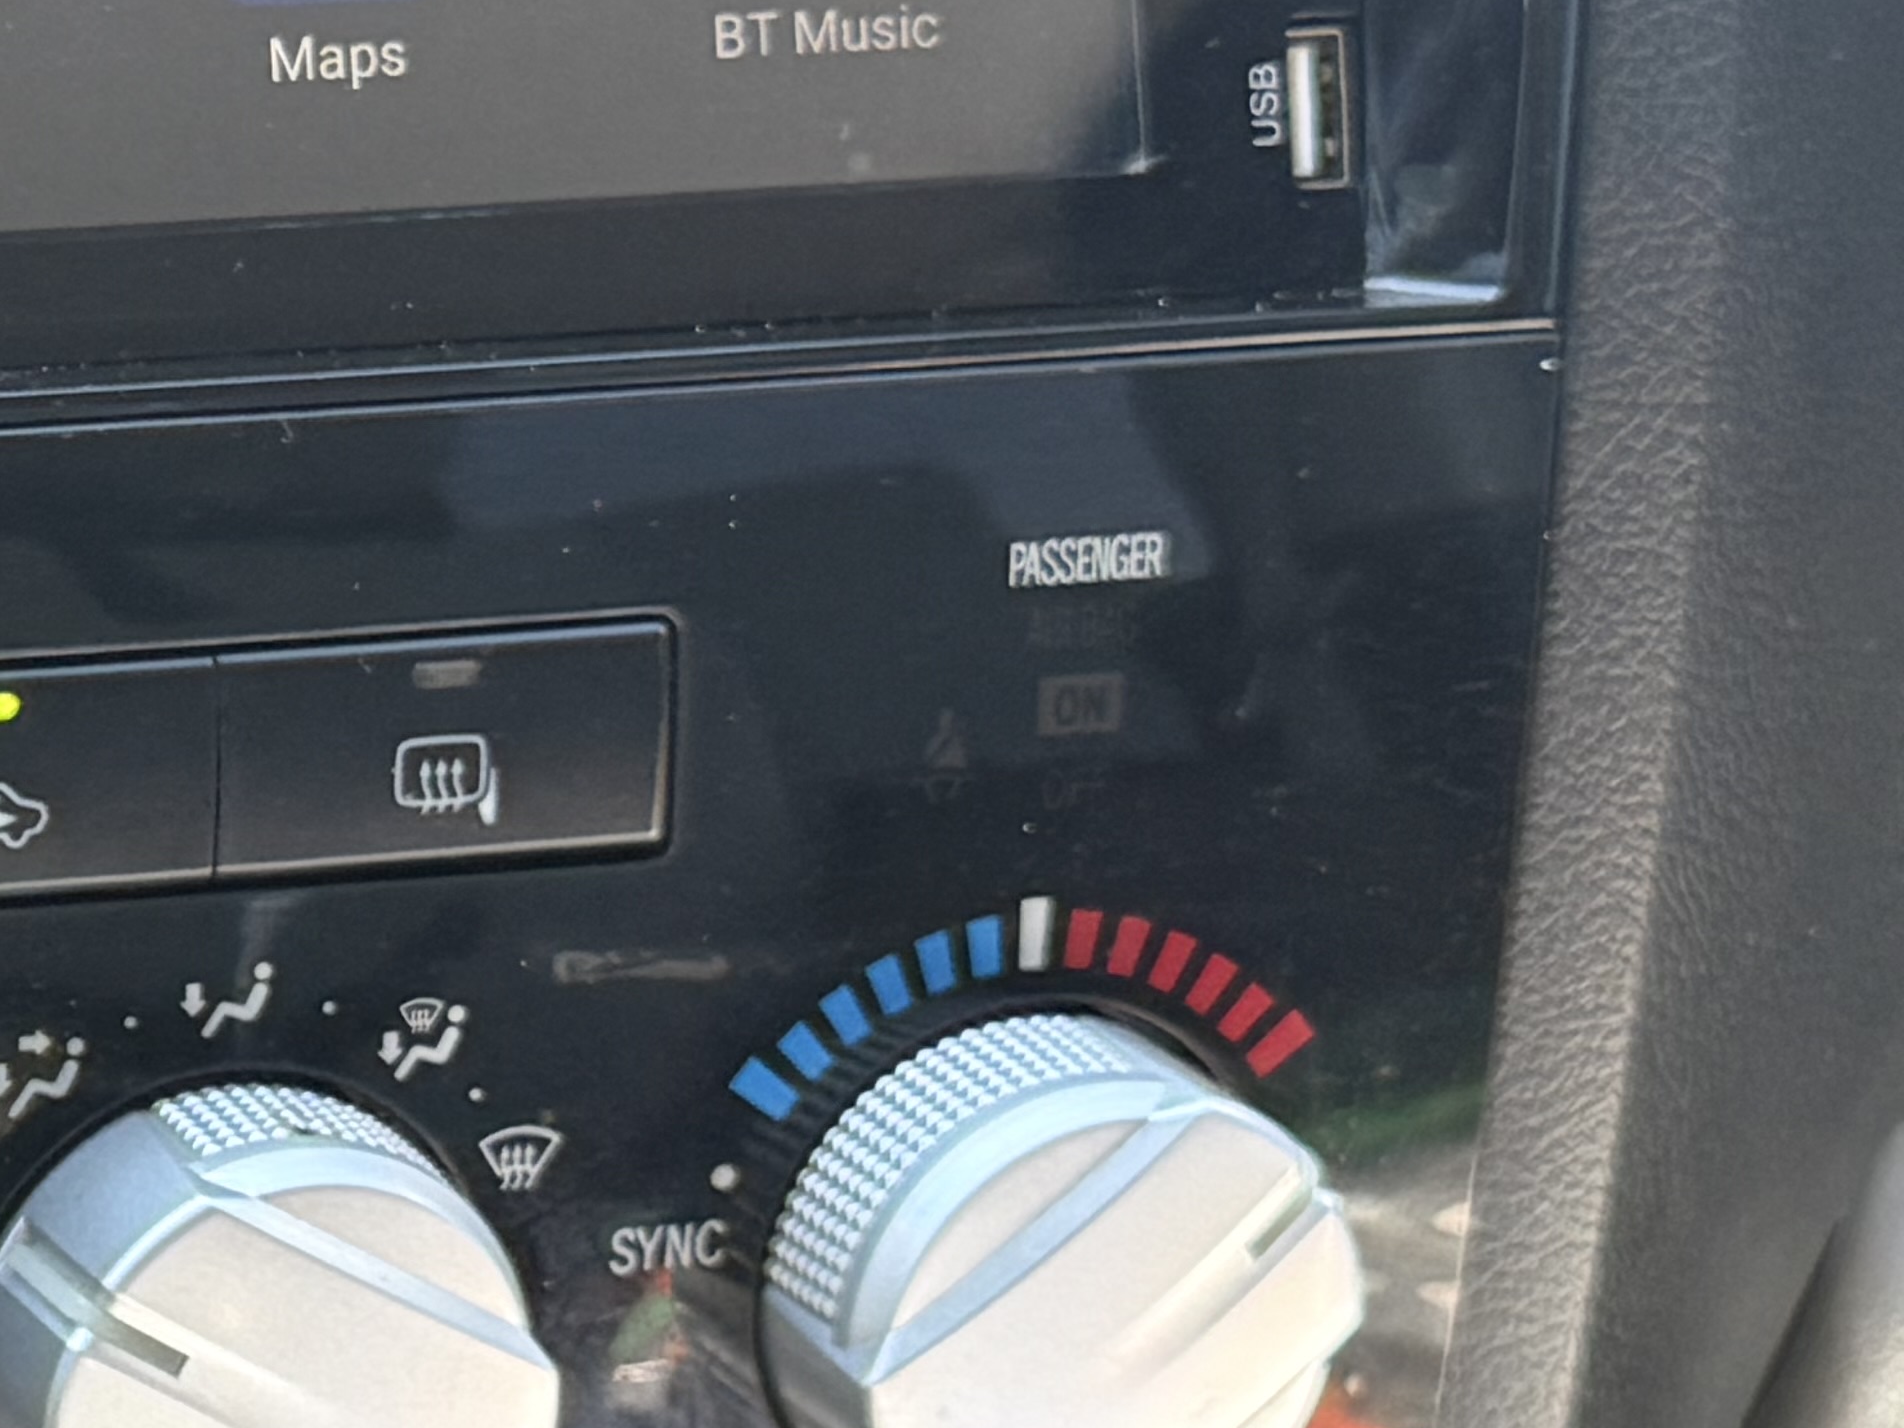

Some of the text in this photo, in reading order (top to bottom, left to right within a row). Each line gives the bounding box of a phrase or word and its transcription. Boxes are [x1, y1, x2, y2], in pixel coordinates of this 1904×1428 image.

[714, 5, 939, 59] BT Music
[269, 36, 407, 90] Maps
[1248, 61, 1281, 148] USB
[1008, 531, 1170, 587] PASSENGER
[608, 1220, 727, 1275] SYNC
